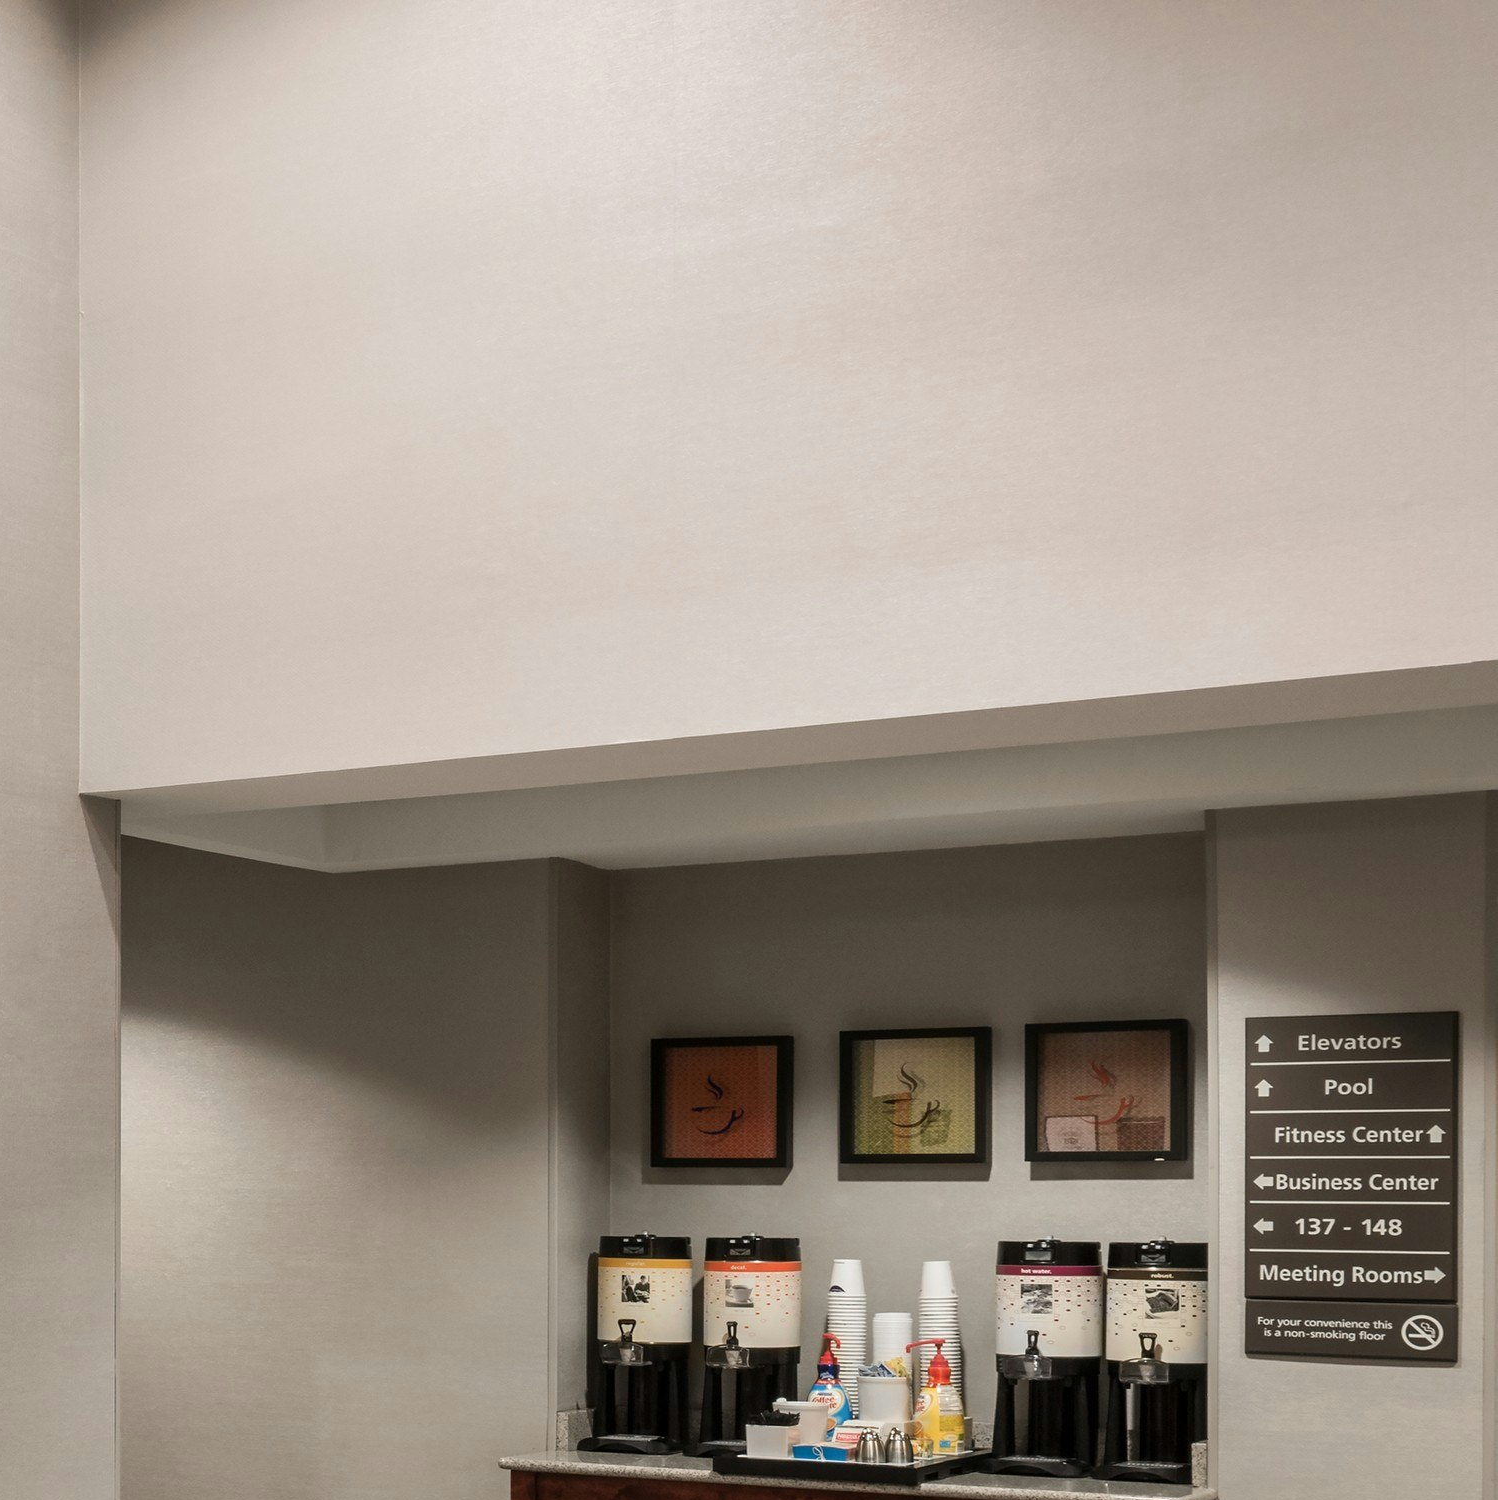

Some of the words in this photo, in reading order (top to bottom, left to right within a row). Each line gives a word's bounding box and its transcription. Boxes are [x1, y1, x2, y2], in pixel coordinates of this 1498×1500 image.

[1297, 1033, 1402, 1051] Elevators
[1324, 1078, 1373, 1096] Pool
[1274, 1126, 1346, 1144] Fitness
[1353, 1126, 1423, 1143] Center
[1275, 1174, 1362, 1191] Business
[1369, 1174, 1439, 1191] Center
[1295, 1218, 1335, 1235] 137
[1361, 1218, 1403, 1236] 148
[1259, 1265, 1345, 1286] Meeting
[1352, 1267, 1423, 1284] Rooms
[1257, 1317, 1275, 1326] For
[1277, 1318, 1302, 1328] your
[1304, 1318, 1370, 1329] convenience
[1373, 1320, 1393, 1330] this
[1264, 1328, 1272, 1337] is
[1284, 1330, 1356, 1342] non-smoking
[1359, 1330, 1386, 1341] floor
